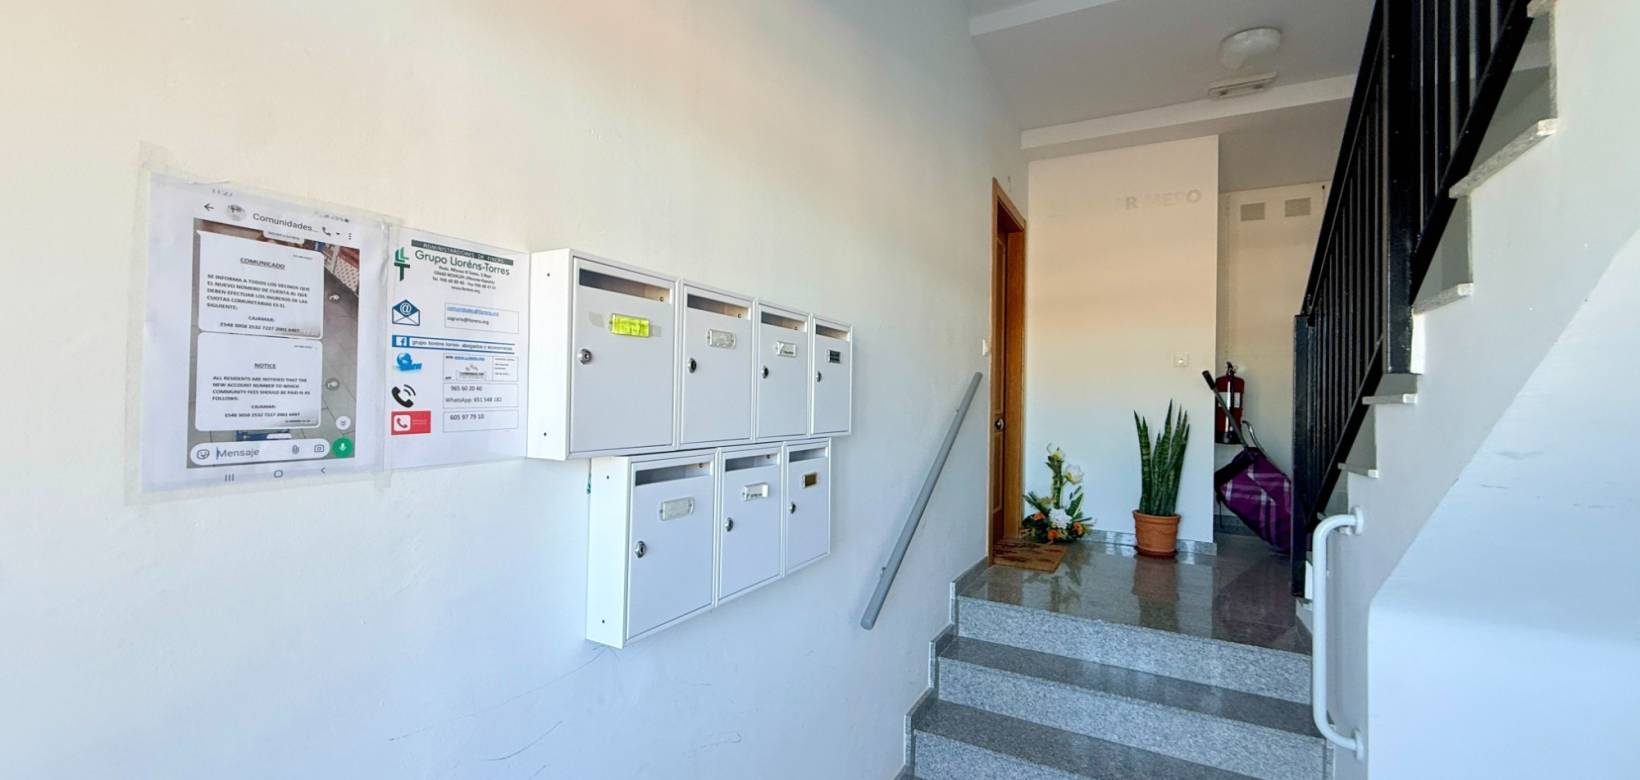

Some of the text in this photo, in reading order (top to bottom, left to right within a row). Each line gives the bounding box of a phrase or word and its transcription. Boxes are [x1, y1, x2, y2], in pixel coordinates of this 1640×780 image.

[240, 257, 286, 270] COMUNICADO
[415, 250, 448, 265] Grupo
[215, 281, 235, 289] NUEVO
[217, 447, 260, 459] Mensaje
